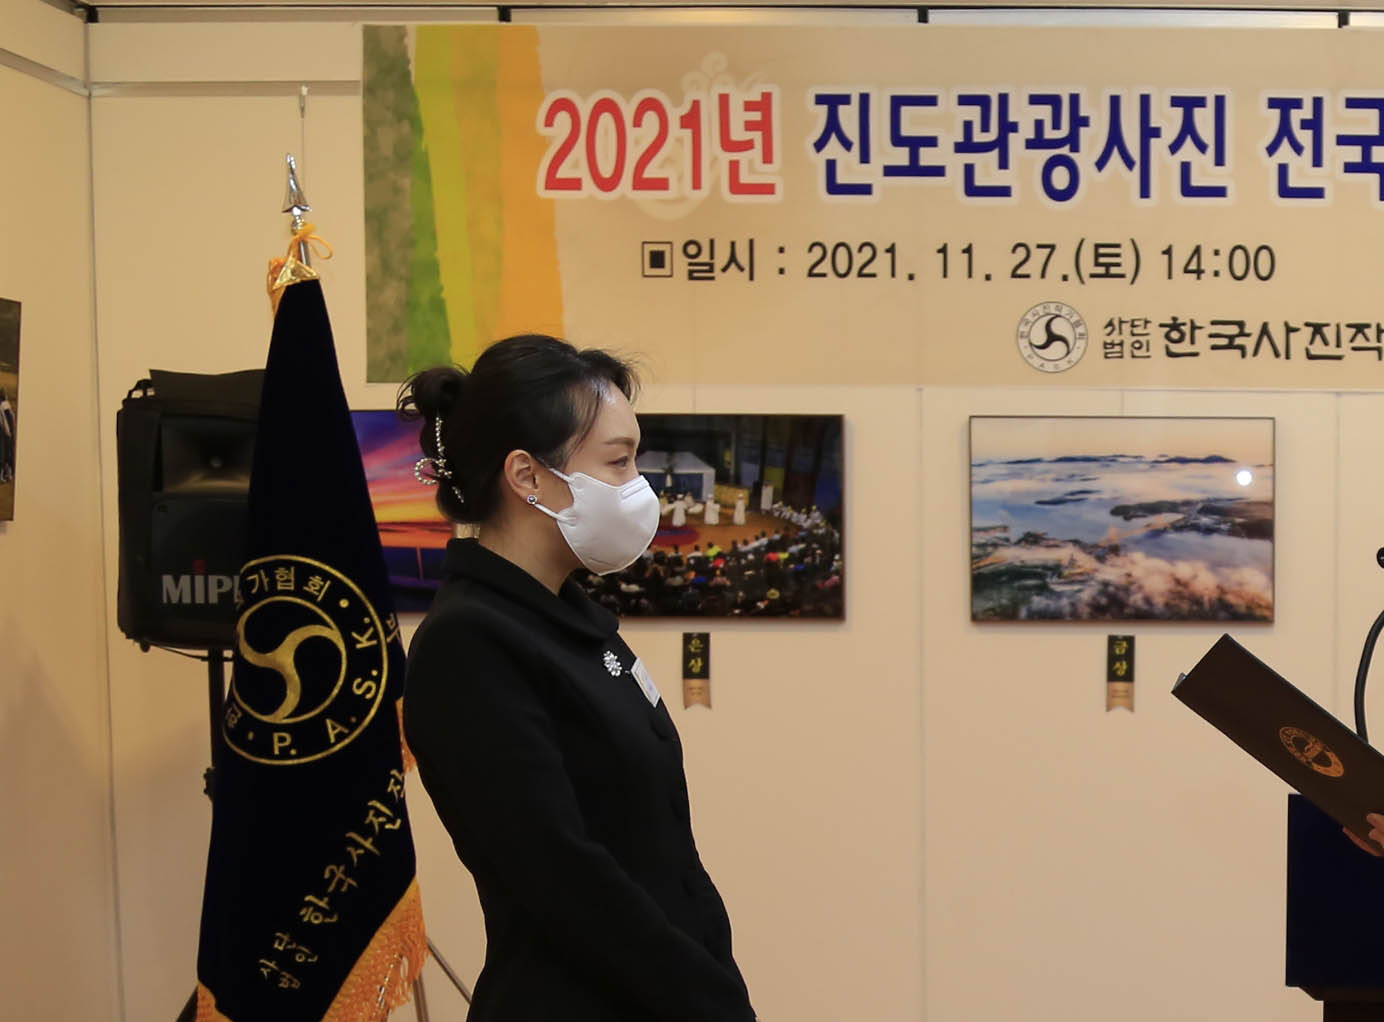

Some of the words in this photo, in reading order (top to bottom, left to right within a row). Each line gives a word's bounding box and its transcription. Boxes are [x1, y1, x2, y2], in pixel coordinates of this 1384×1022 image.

[543, 91, 777, 197] 2021년
[812, 92, 1229, 202] 진도관광사진
[681, 238, 756, 283] 일시
[806, 242, 916, 282] 2021.
[935, 243, 993, 282] 11.
[1010, 239, 1142, 285] 27.(토)
[1160, 244, 1277, 283] 14:00
[1103, 317, 1152, 337] 사단
[1103, 339, 1152, 360] 법인
[162, 574, 241, 604] MIP
